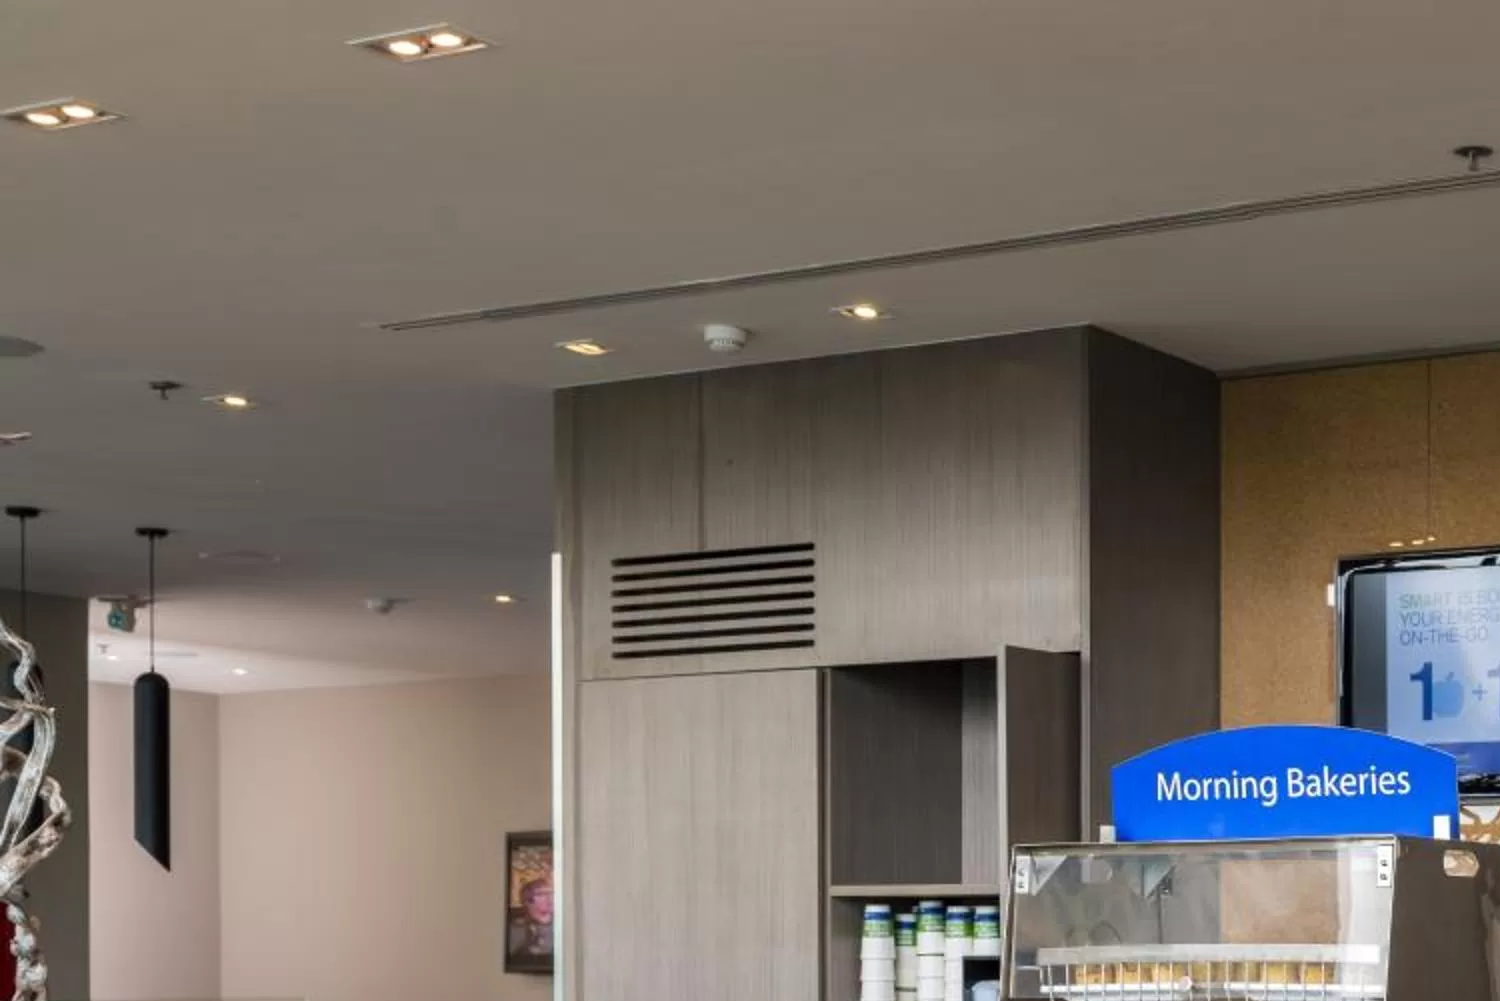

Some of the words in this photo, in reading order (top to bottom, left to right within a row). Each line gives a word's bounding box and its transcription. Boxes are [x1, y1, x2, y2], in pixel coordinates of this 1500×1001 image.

[1399, 592, 1452, 609] SMART
[1399, 609, 1443, 627] YOUR
[1399, 626, 1489, 646] ON-THE-GO
[1410, 661, 1433, 721] 1
[1157, 771, 1278, 807] Morning
[1287, 766, 1411, 798] Bakeries
